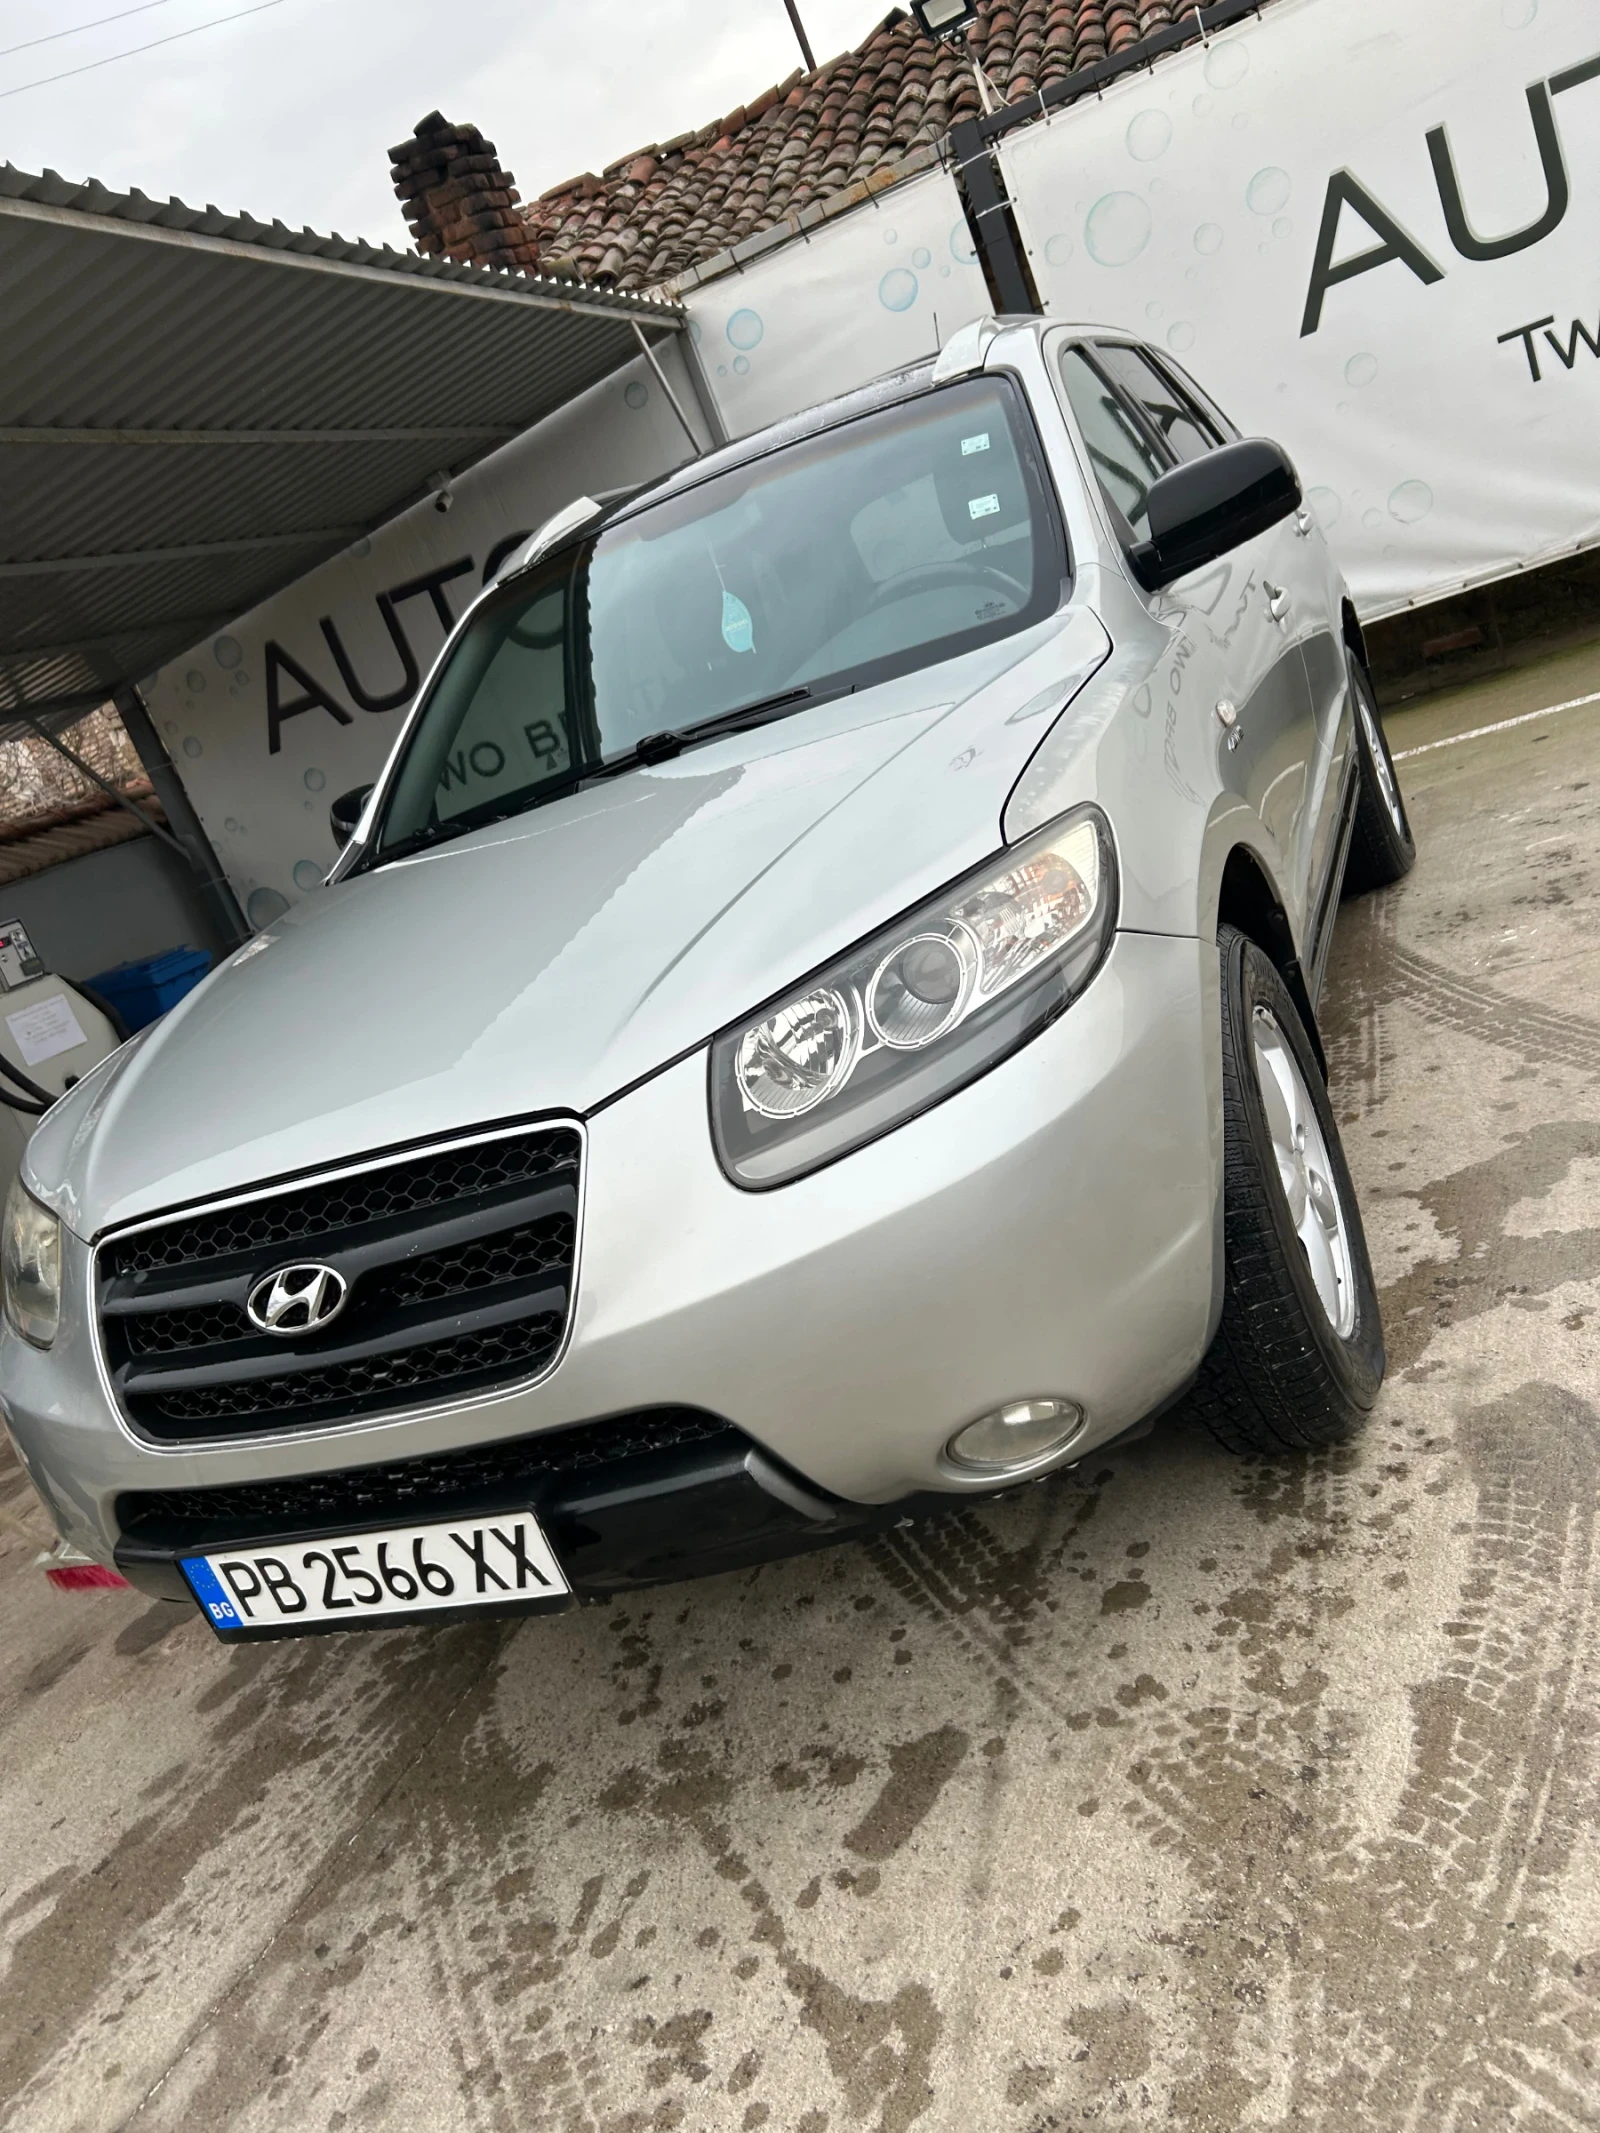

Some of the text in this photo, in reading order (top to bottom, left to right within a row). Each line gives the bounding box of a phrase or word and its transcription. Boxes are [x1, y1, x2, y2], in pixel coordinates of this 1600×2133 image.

[438, 740, 505, 792] WO
[218, 1525, 552, 1617] PB 2566 XX
[209, 1602, 235, 1620] BG
